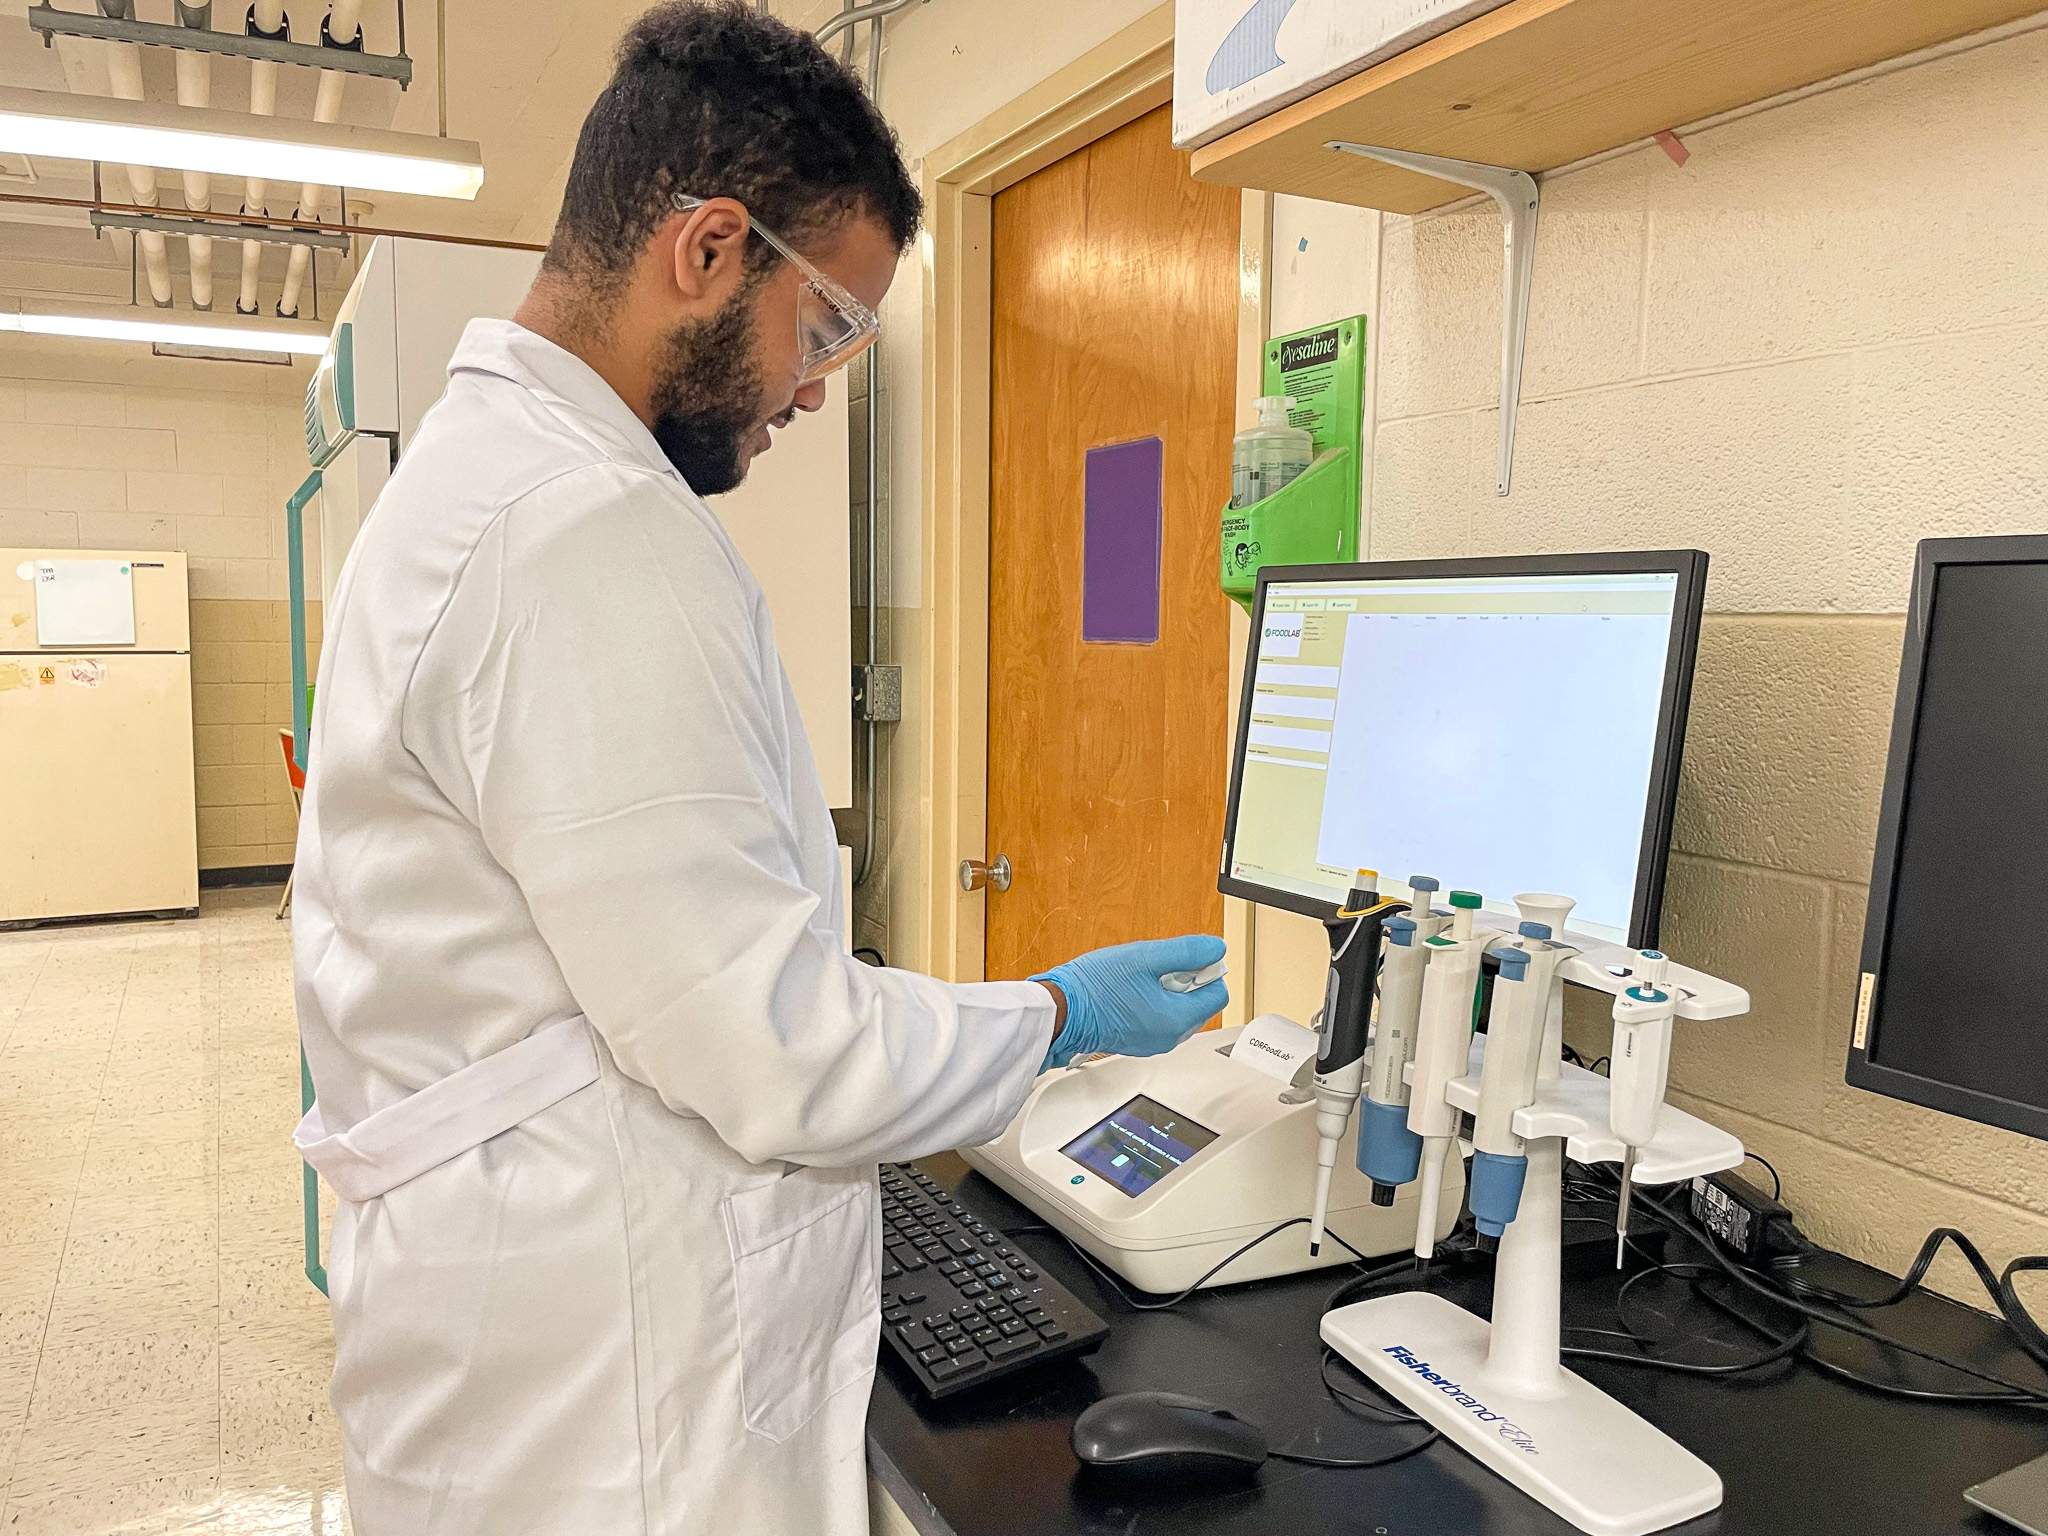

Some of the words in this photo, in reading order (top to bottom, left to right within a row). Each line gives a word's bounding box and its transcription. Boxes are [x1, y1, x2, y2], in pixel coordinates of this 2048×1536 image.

[807, 280, 841, 314] Schmidt
[1282, 335, 1335, 371] eyesaline
[1272, 629, 1300, 638] FOODLAB
[1383, 1346, 1505, 1422] Fisherbrand
